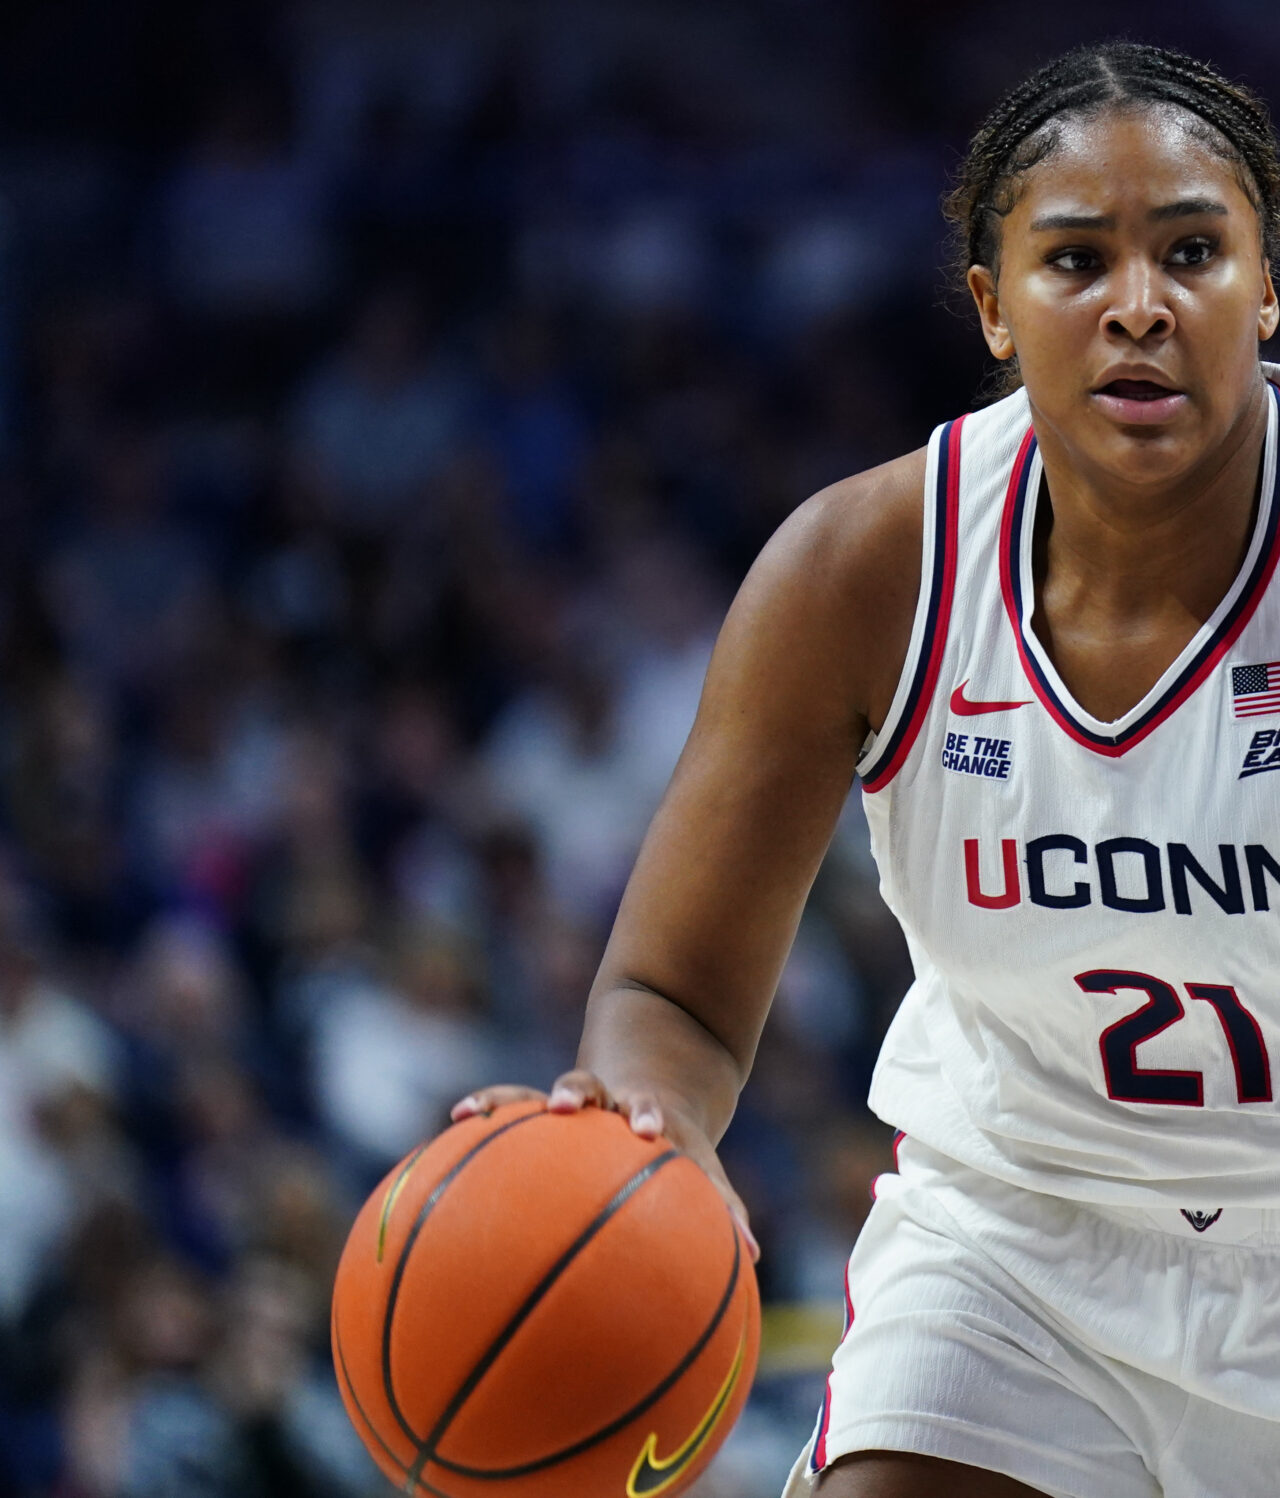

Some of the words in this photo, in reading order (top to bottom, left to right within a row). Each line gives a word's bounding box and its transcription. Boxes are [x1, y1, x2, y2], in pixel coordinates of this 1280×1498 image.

[946, 732, 969, 753] BE
[973, 736, 1012, 759] THE
[941, 749, 1012, 779] CHANGE
[1073, 968, 1273, 1107] 21
